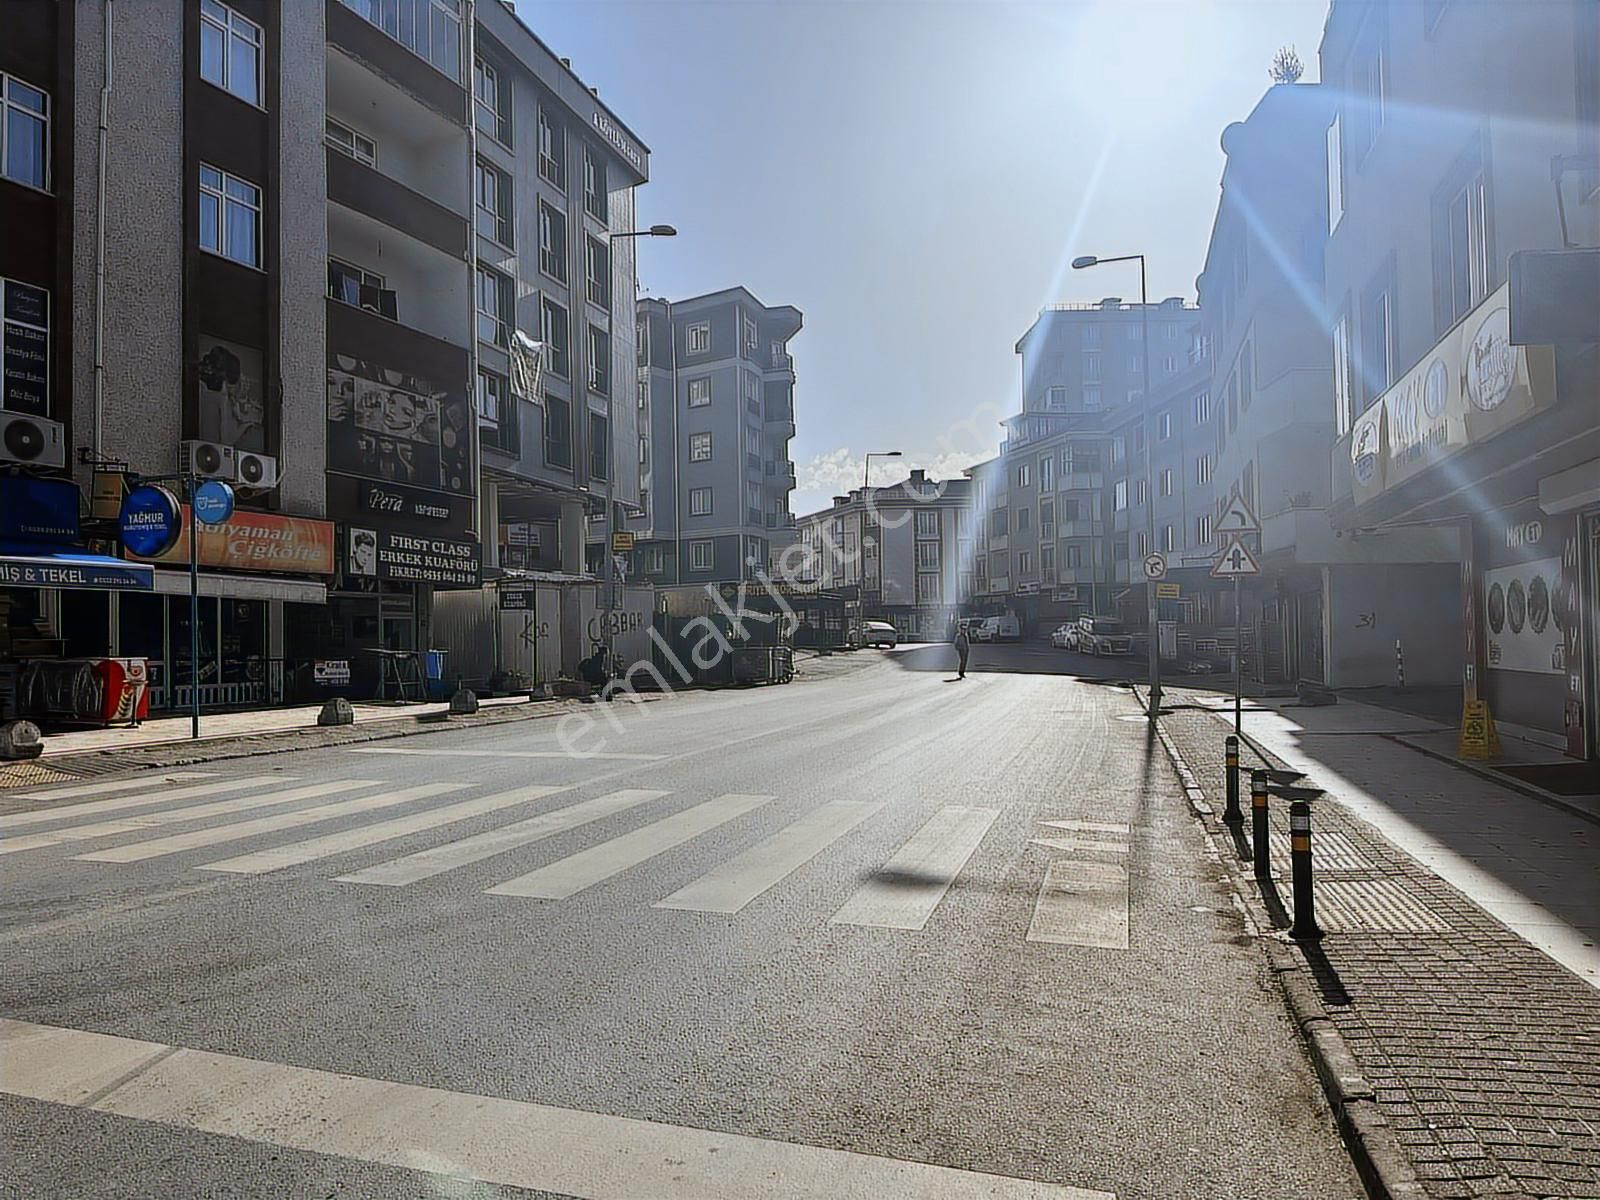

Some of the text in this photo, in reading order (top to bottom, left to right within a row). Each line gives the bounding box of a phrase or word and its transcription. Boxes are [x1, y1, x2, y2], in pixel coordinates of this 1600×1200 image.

[369, 488, 404, 513] Pera
[228, 540, 322, 561] Çiğköfte
[390, 535, 471, 558] FIRST CLASS
[379, 550, 478, 572] ERKEK KUAFÖRÜ
[25, 568, 36, 582] &
[39, 568, 87, 584] TEKEL
